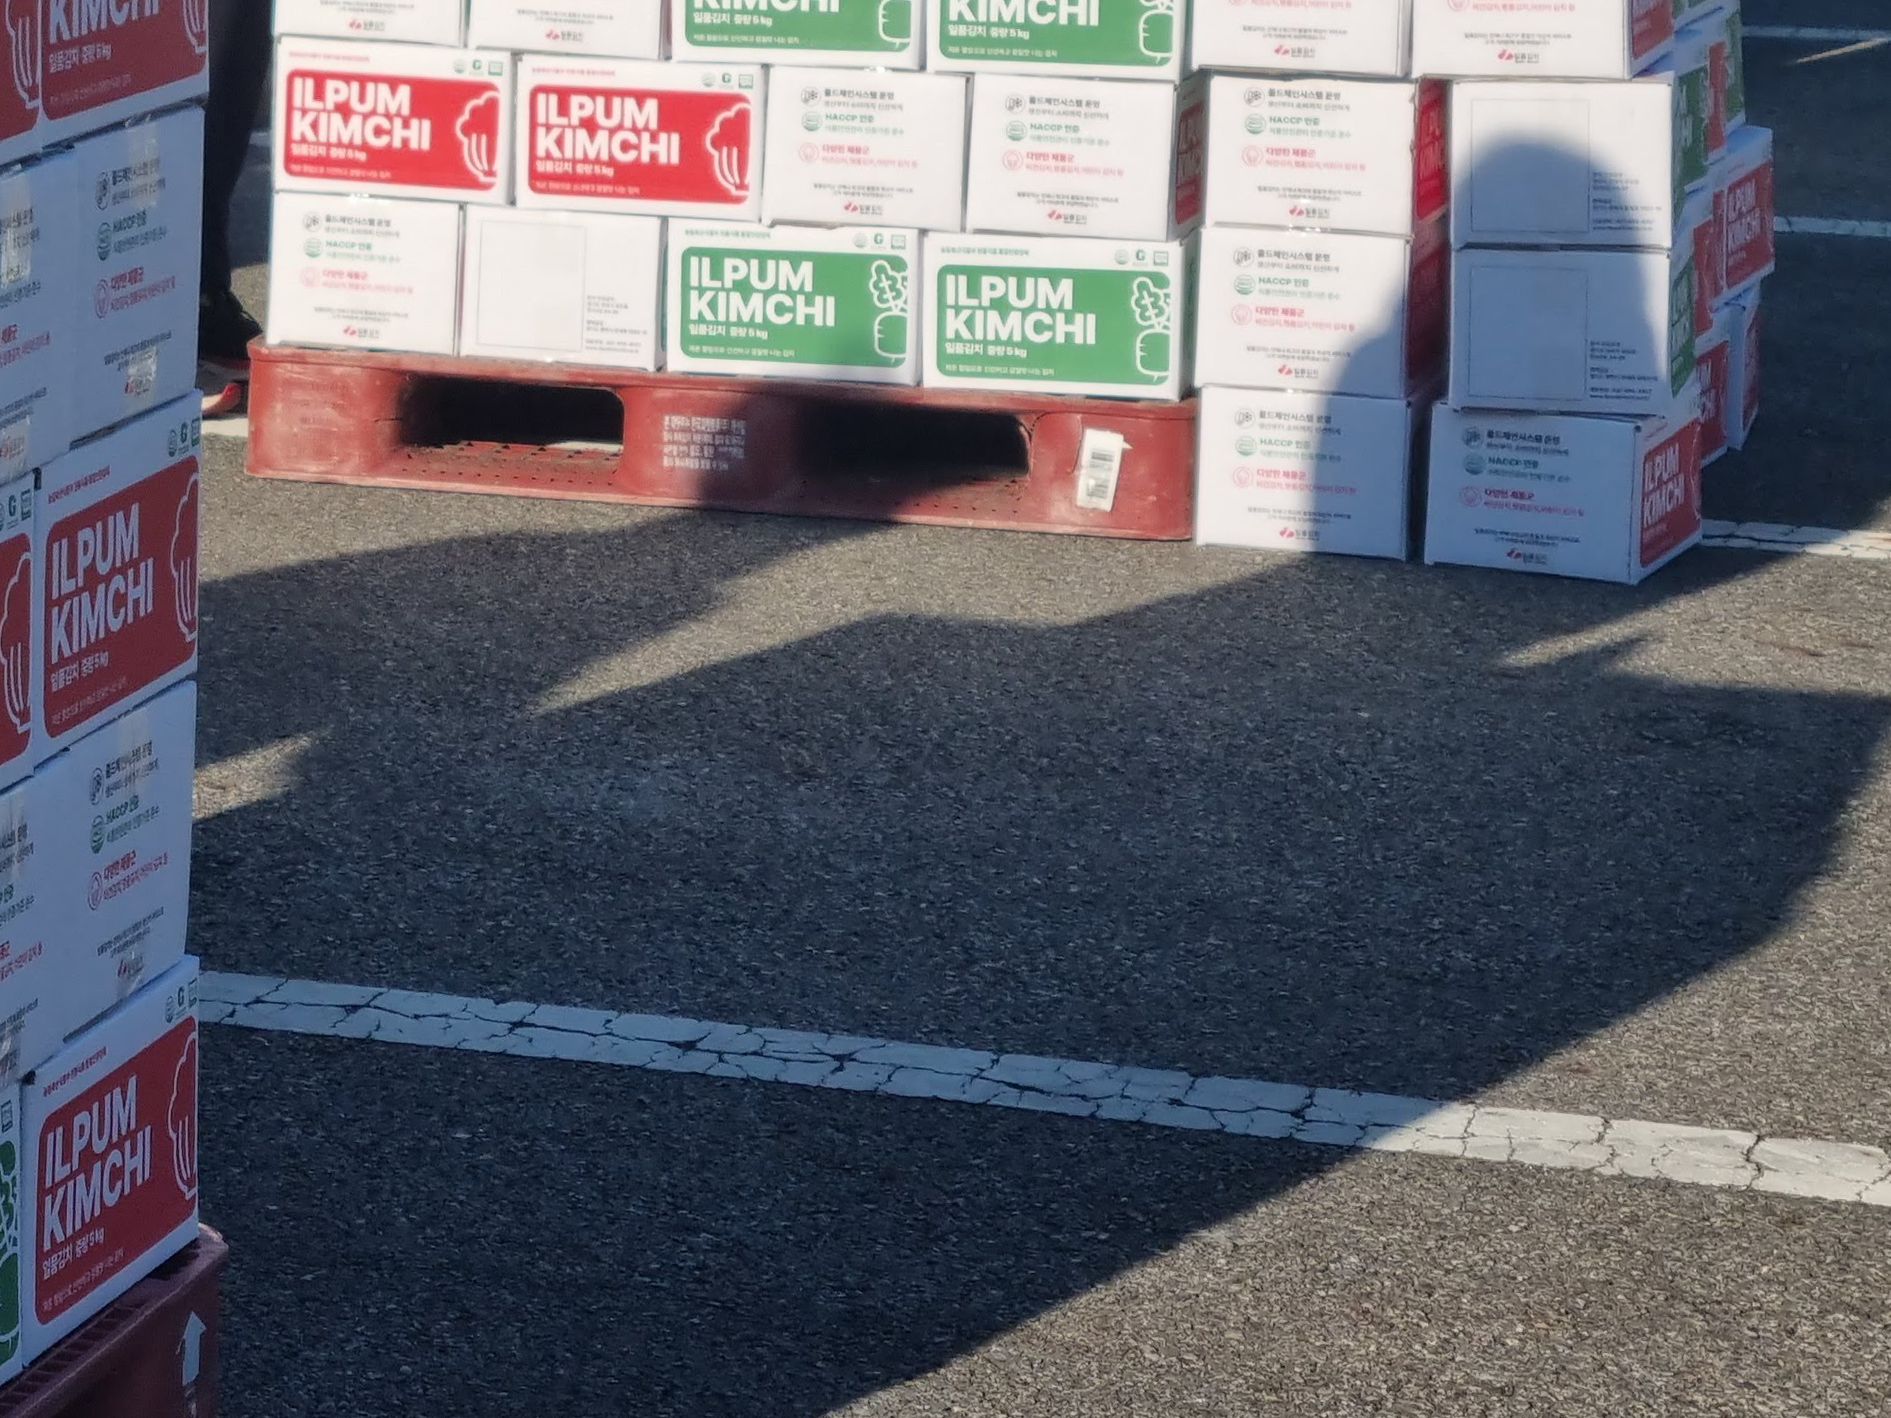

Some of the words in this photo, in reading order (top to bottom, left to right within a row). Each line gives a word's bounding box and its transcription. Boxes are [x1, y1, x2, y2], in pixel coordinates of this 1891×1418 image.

[292, 77, 410, 116] ILPUM
[536, 92, 658, 130] ILPUM
[291, 109, 430, 150] KIMCHI
[536, 126, 679, 164] KIMCHI
[689, 255, 813, 292] ILPUM
[945, 274, 1073, 310] ILPUM
[689, 289, 835, 326] KIMCHI
[945, 308, 1096, 344] KIMCHI
[1644, 443, 1680, 488] ILPUM
[51, 502, 139, 600] ILPUM
[51, 557, 153, 664] KIMCHI
[45, 1074, 137, 1189] ILPUM
[43, 1125, 151, 1252] KIMCHI
